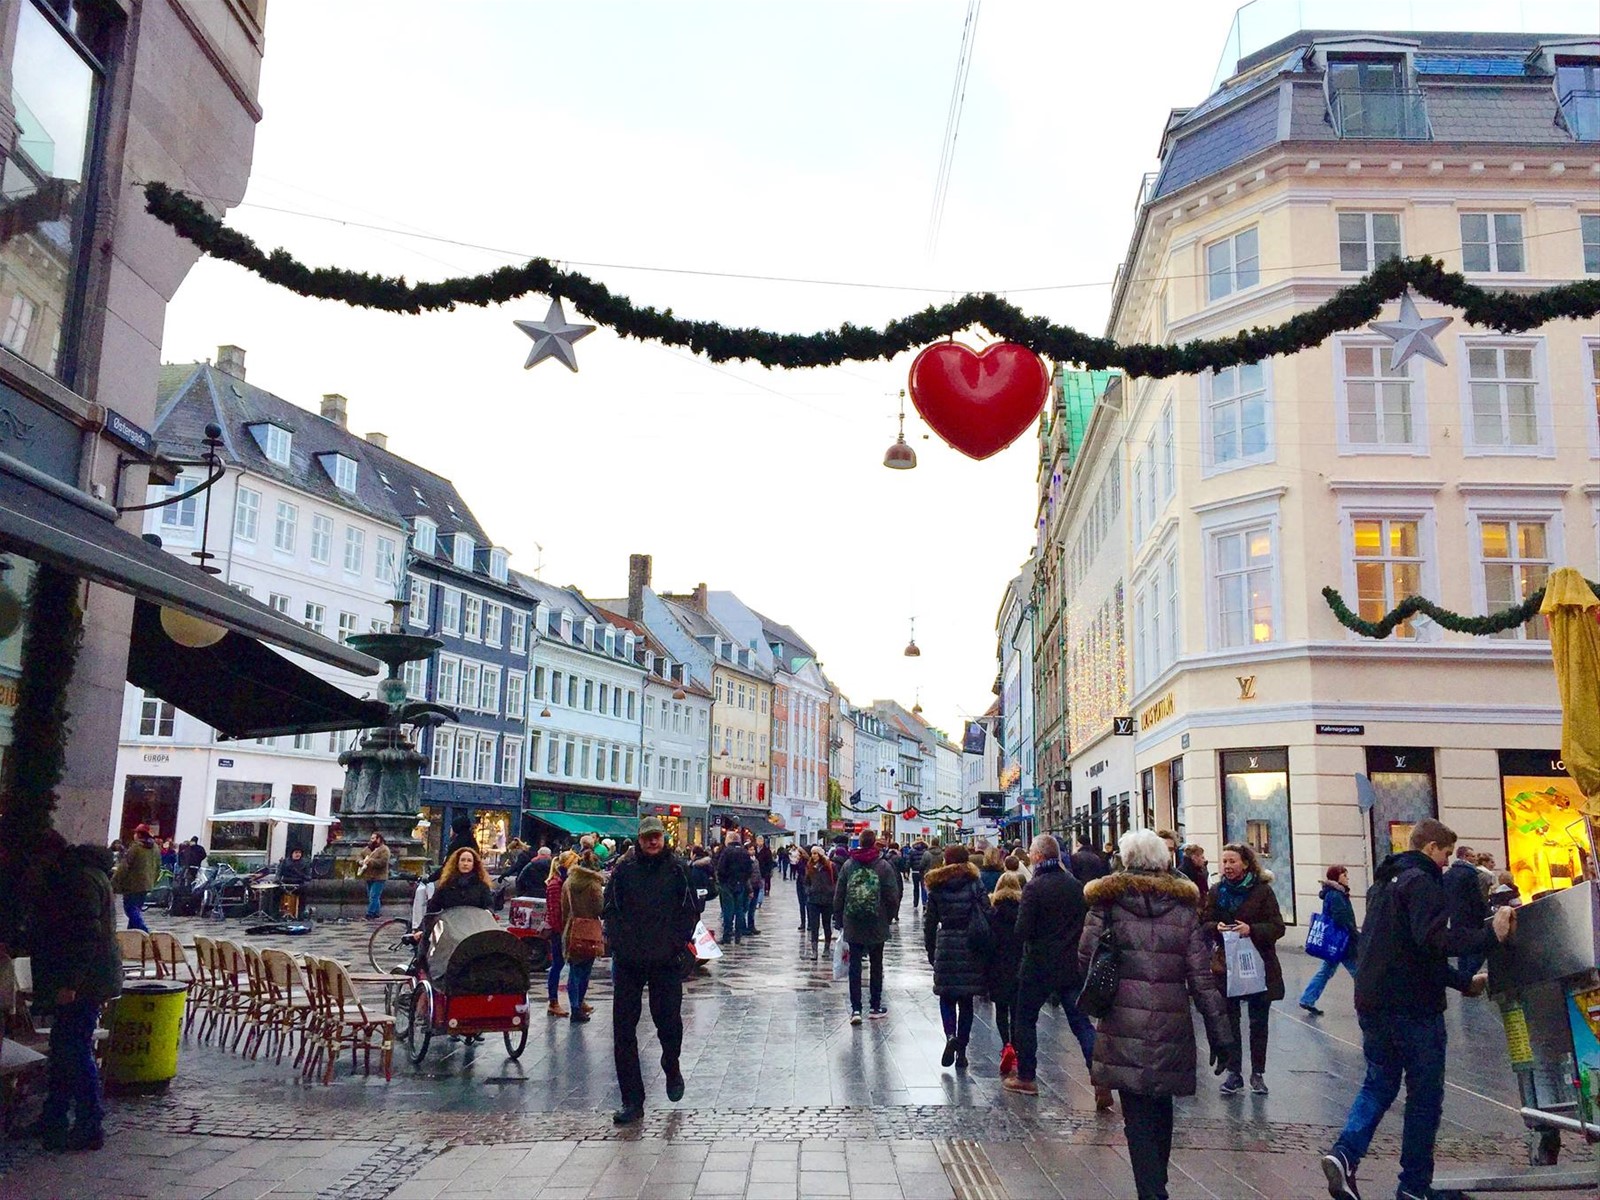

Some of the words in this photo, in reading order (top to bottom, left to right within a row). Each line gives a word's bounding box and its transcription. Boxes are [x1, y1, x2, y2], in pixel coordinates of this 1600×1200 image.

[113, 417, 146, 446] Østergade
[143, 754, 169, 763] EUROPA
[1312, 920, 1329, 931] MY
[1307, 935, 1323, 946] BAG
